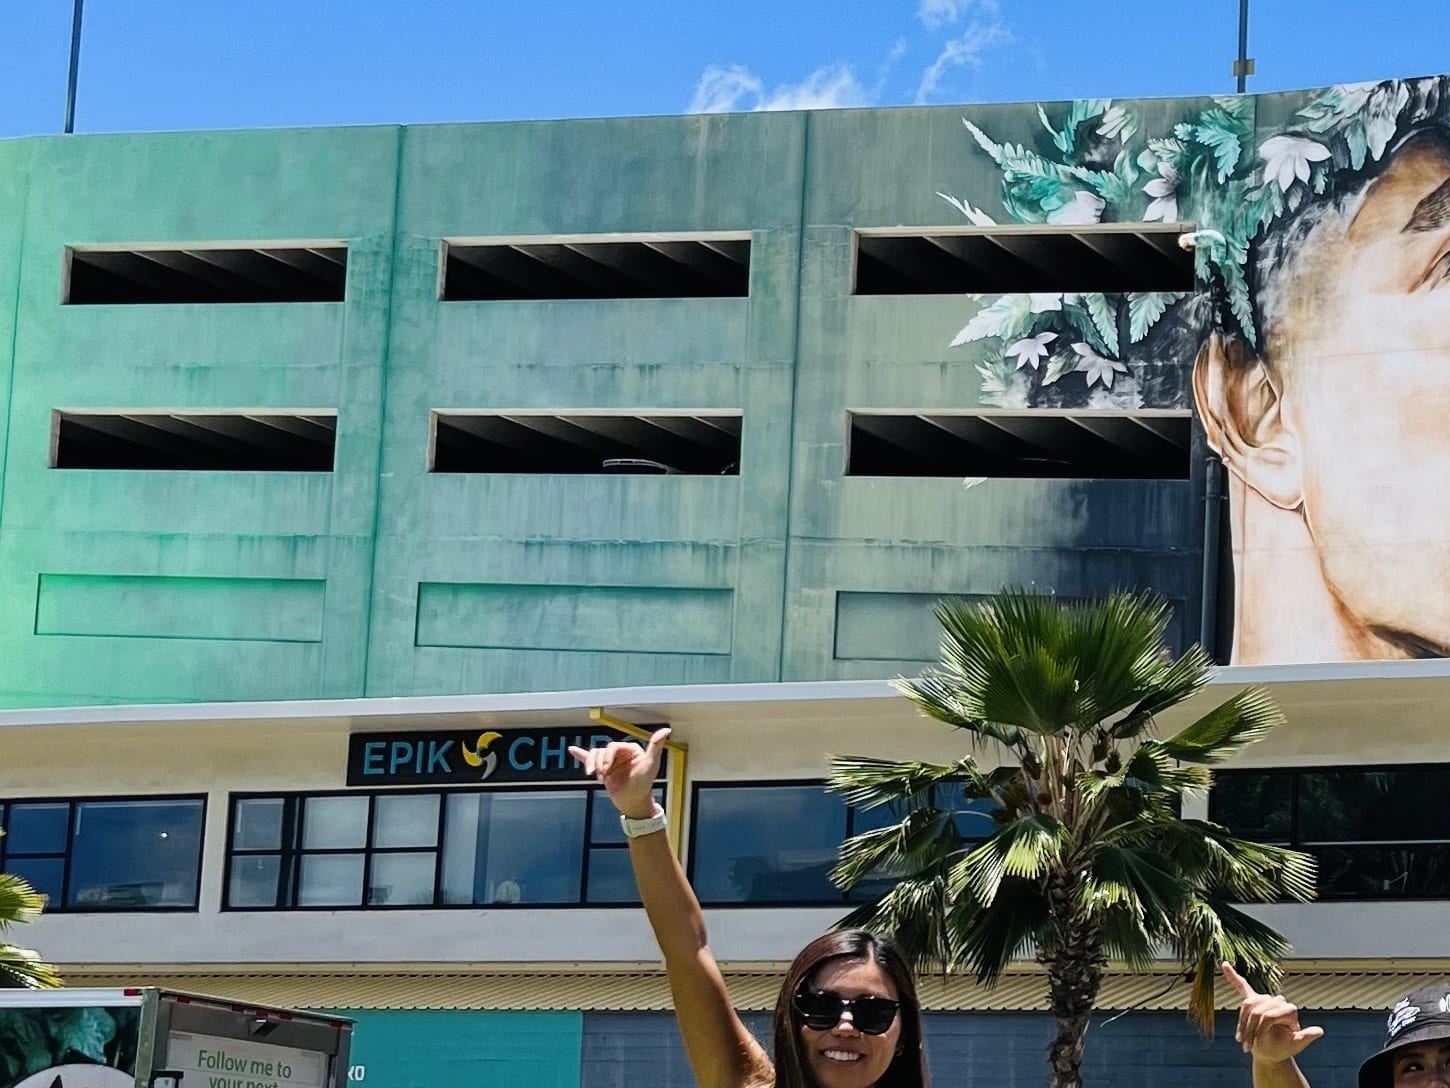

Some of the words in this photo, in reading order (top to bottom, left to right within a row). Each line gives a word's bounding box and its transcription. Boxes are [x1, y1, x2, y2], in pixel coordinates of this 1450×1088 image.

[364, 741, 454, 774] EPIK
[198, 1050, 247, 1072] Follow
[251, 1061, 273, 1076] me
[278, 1062, 292, 1079] to
